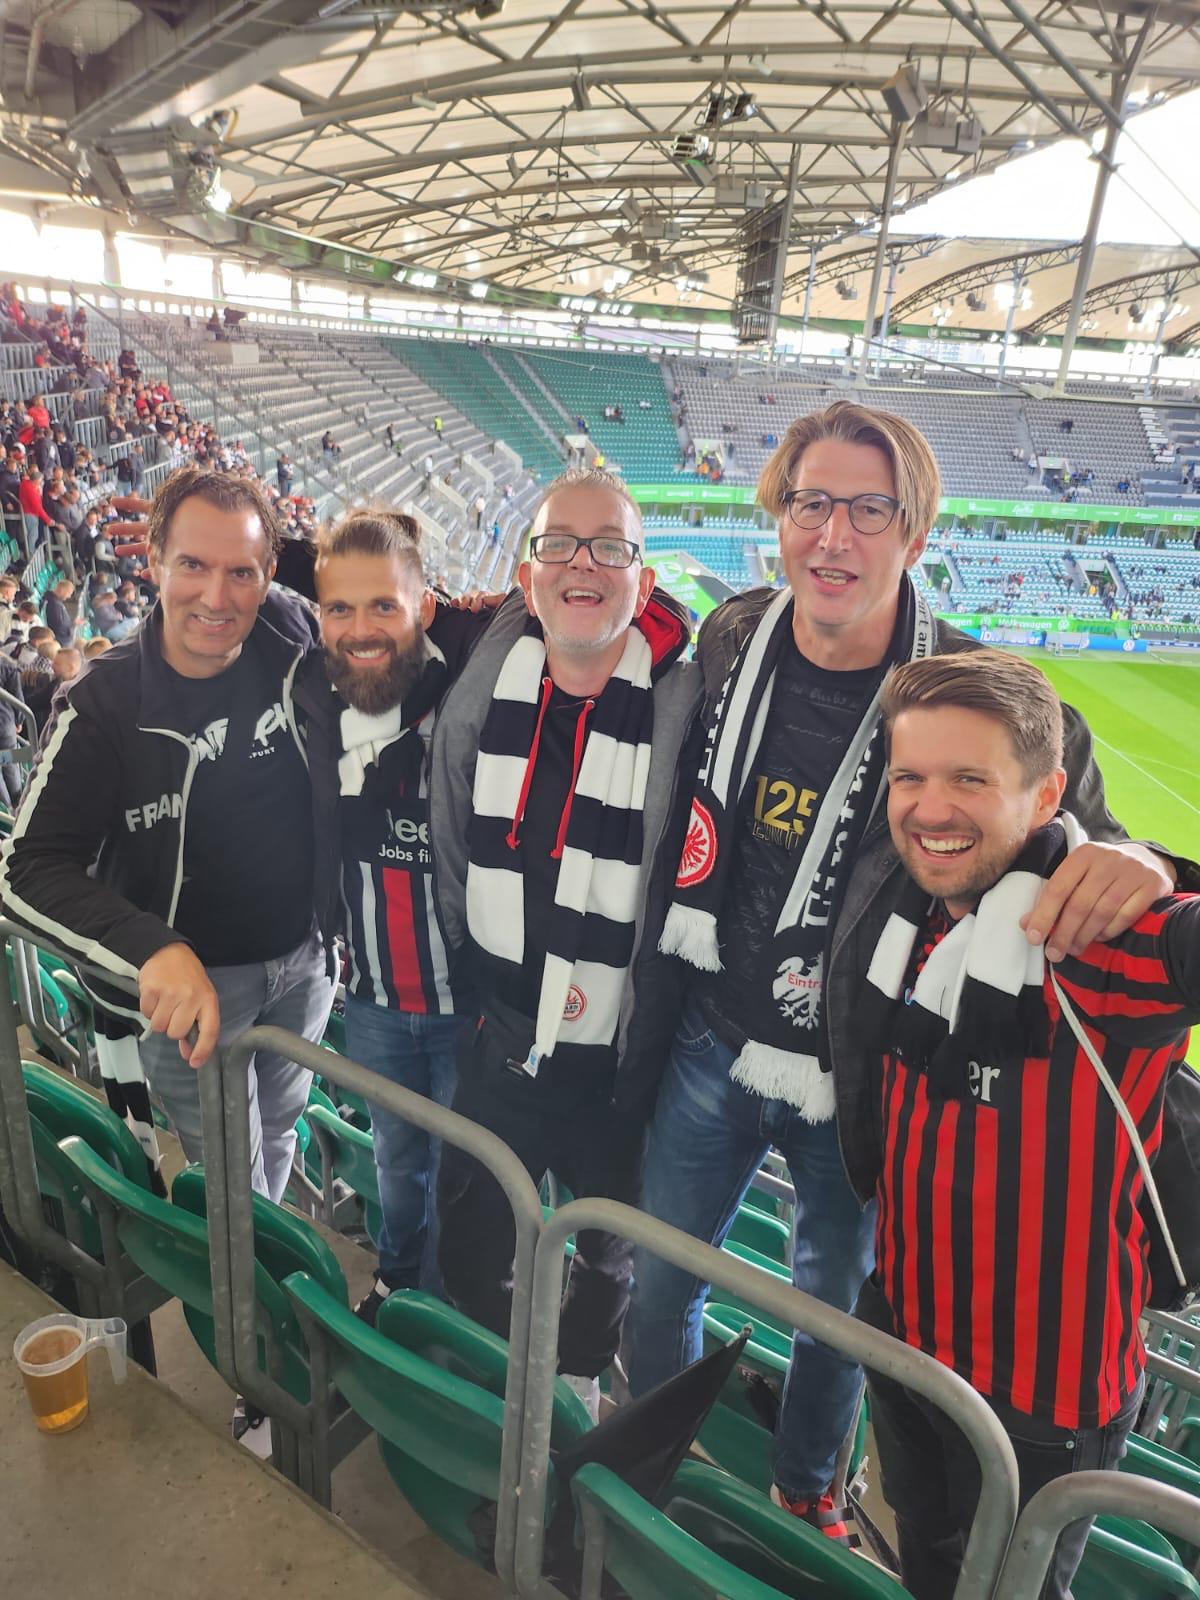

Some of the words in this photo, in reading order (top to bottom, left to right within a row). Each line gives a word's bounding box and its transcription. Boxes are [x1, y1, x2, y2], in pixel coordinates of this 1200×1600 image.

[755, 775, 818, 836] 125
[378, 843, 413, 862] Jobs
[787, 973, 823, 989] Eintr
[968, 1060, 1000, 1102] er
